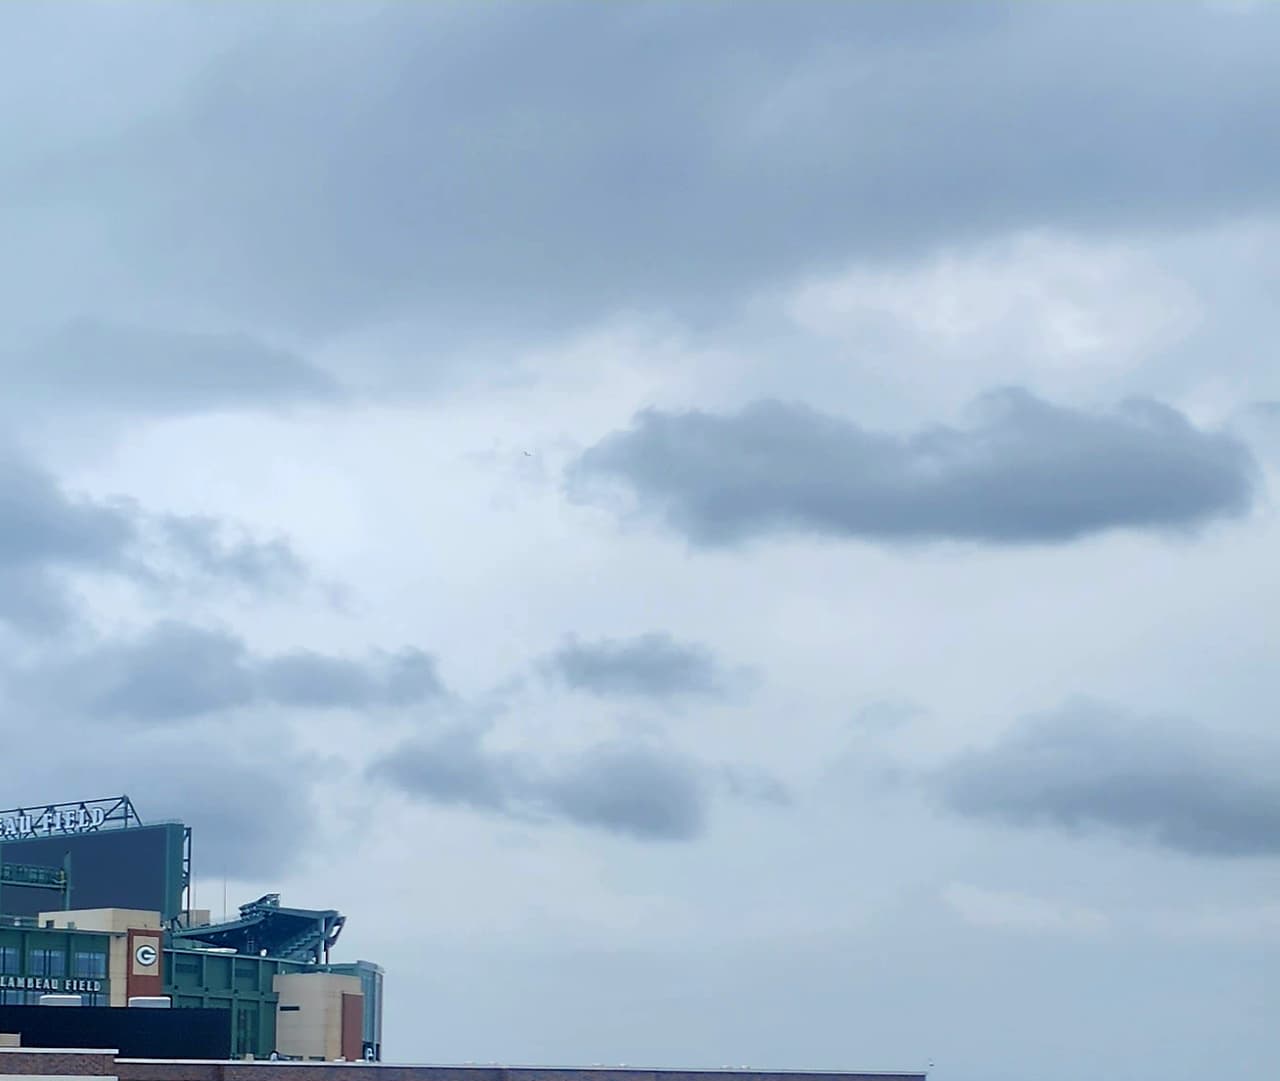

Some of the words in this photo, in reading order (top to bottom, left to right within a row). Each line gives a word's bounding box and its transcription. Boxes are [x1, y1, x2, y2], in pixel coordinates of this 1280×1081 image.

[42, 807, 105, 832] FIELD
[0, 976, 59, 990] LAMBEAU
[65, 979, 101, 992] FIELD
